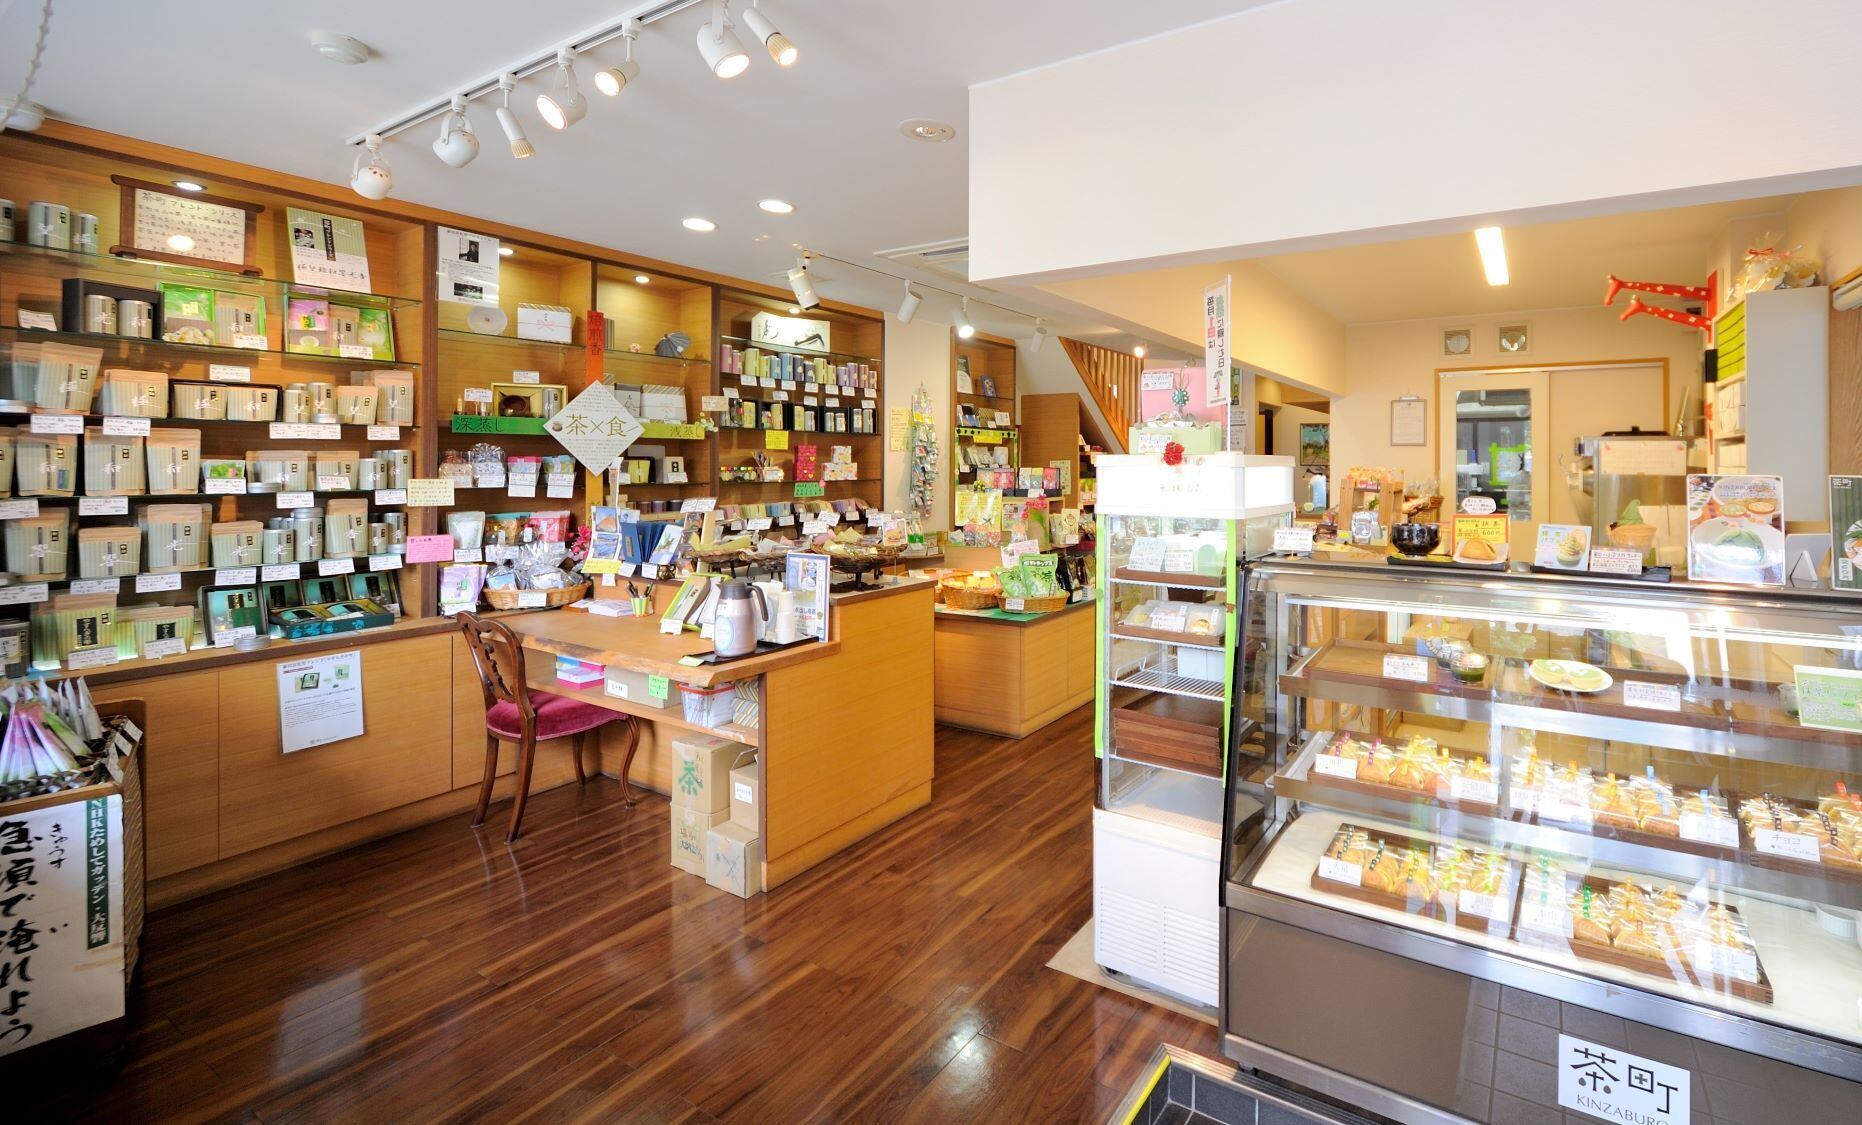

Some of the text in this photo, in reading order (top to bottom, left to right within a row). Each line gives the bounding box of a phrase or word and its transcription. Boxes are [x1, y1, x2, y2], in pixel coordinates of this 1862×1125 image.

[455, 416, 504, 433] 深蒸し
[565, 413, 627, 437] 茶×食
[670, 424, 705, 438] 浅蒸し
[678, 760, 704, 797] 茶
[48, 823, 69, 869] きゅうす
[1771, 833, 1802, 845] チョコ
[0, 820, 43, 1045] 急須で淹れよう
[1570, 1047, 1679, 1115] 茶町
